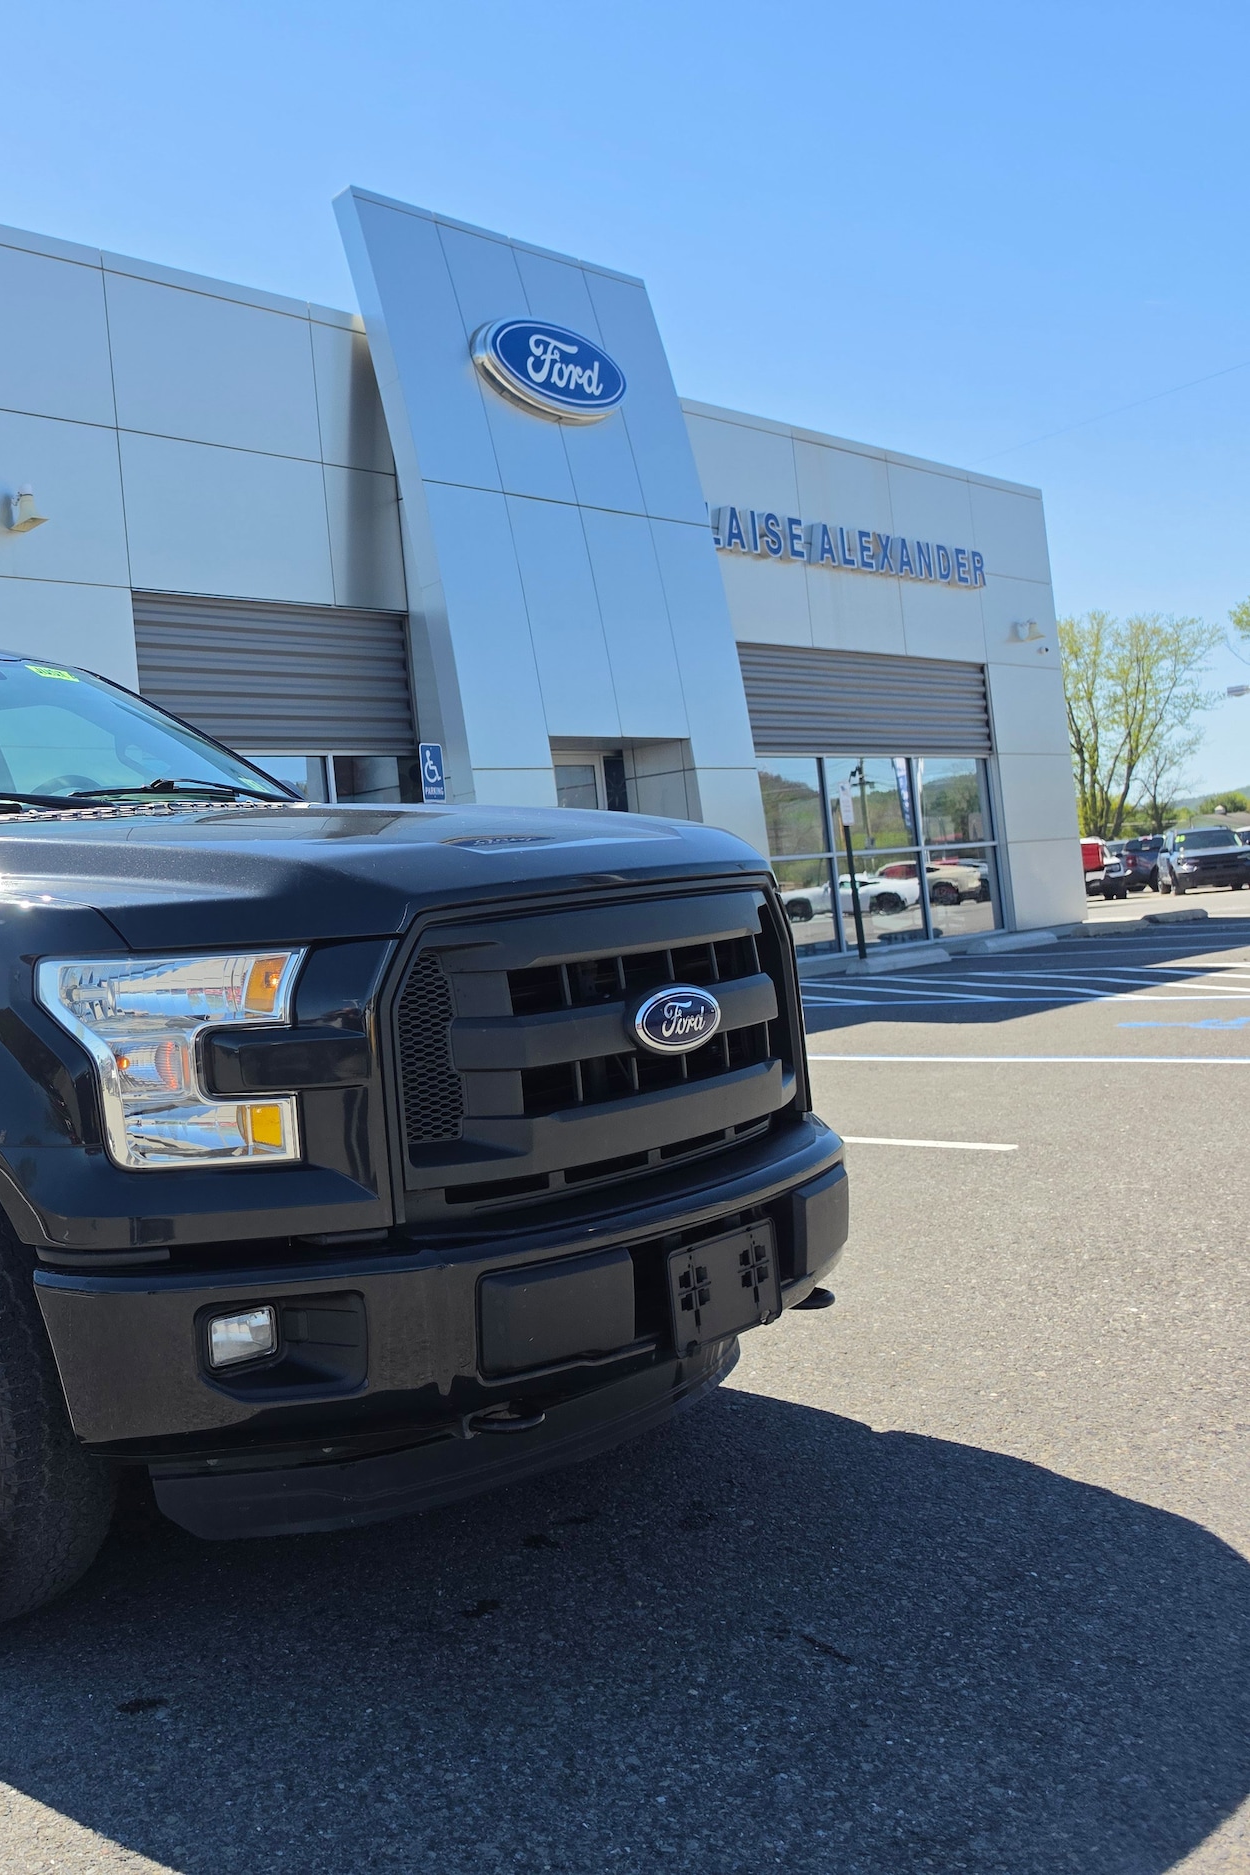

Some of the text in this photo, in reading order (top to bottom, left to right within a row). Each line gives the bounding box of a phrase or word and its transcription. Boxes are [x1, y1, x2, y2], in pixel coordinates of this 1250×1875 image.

[526, 334, 603, 396] Ford
[819, 523, 987, 587] ALEXANDER
[425, 786, 444, 796] PARKING
[662, 1000, 706, 1038] Ford
